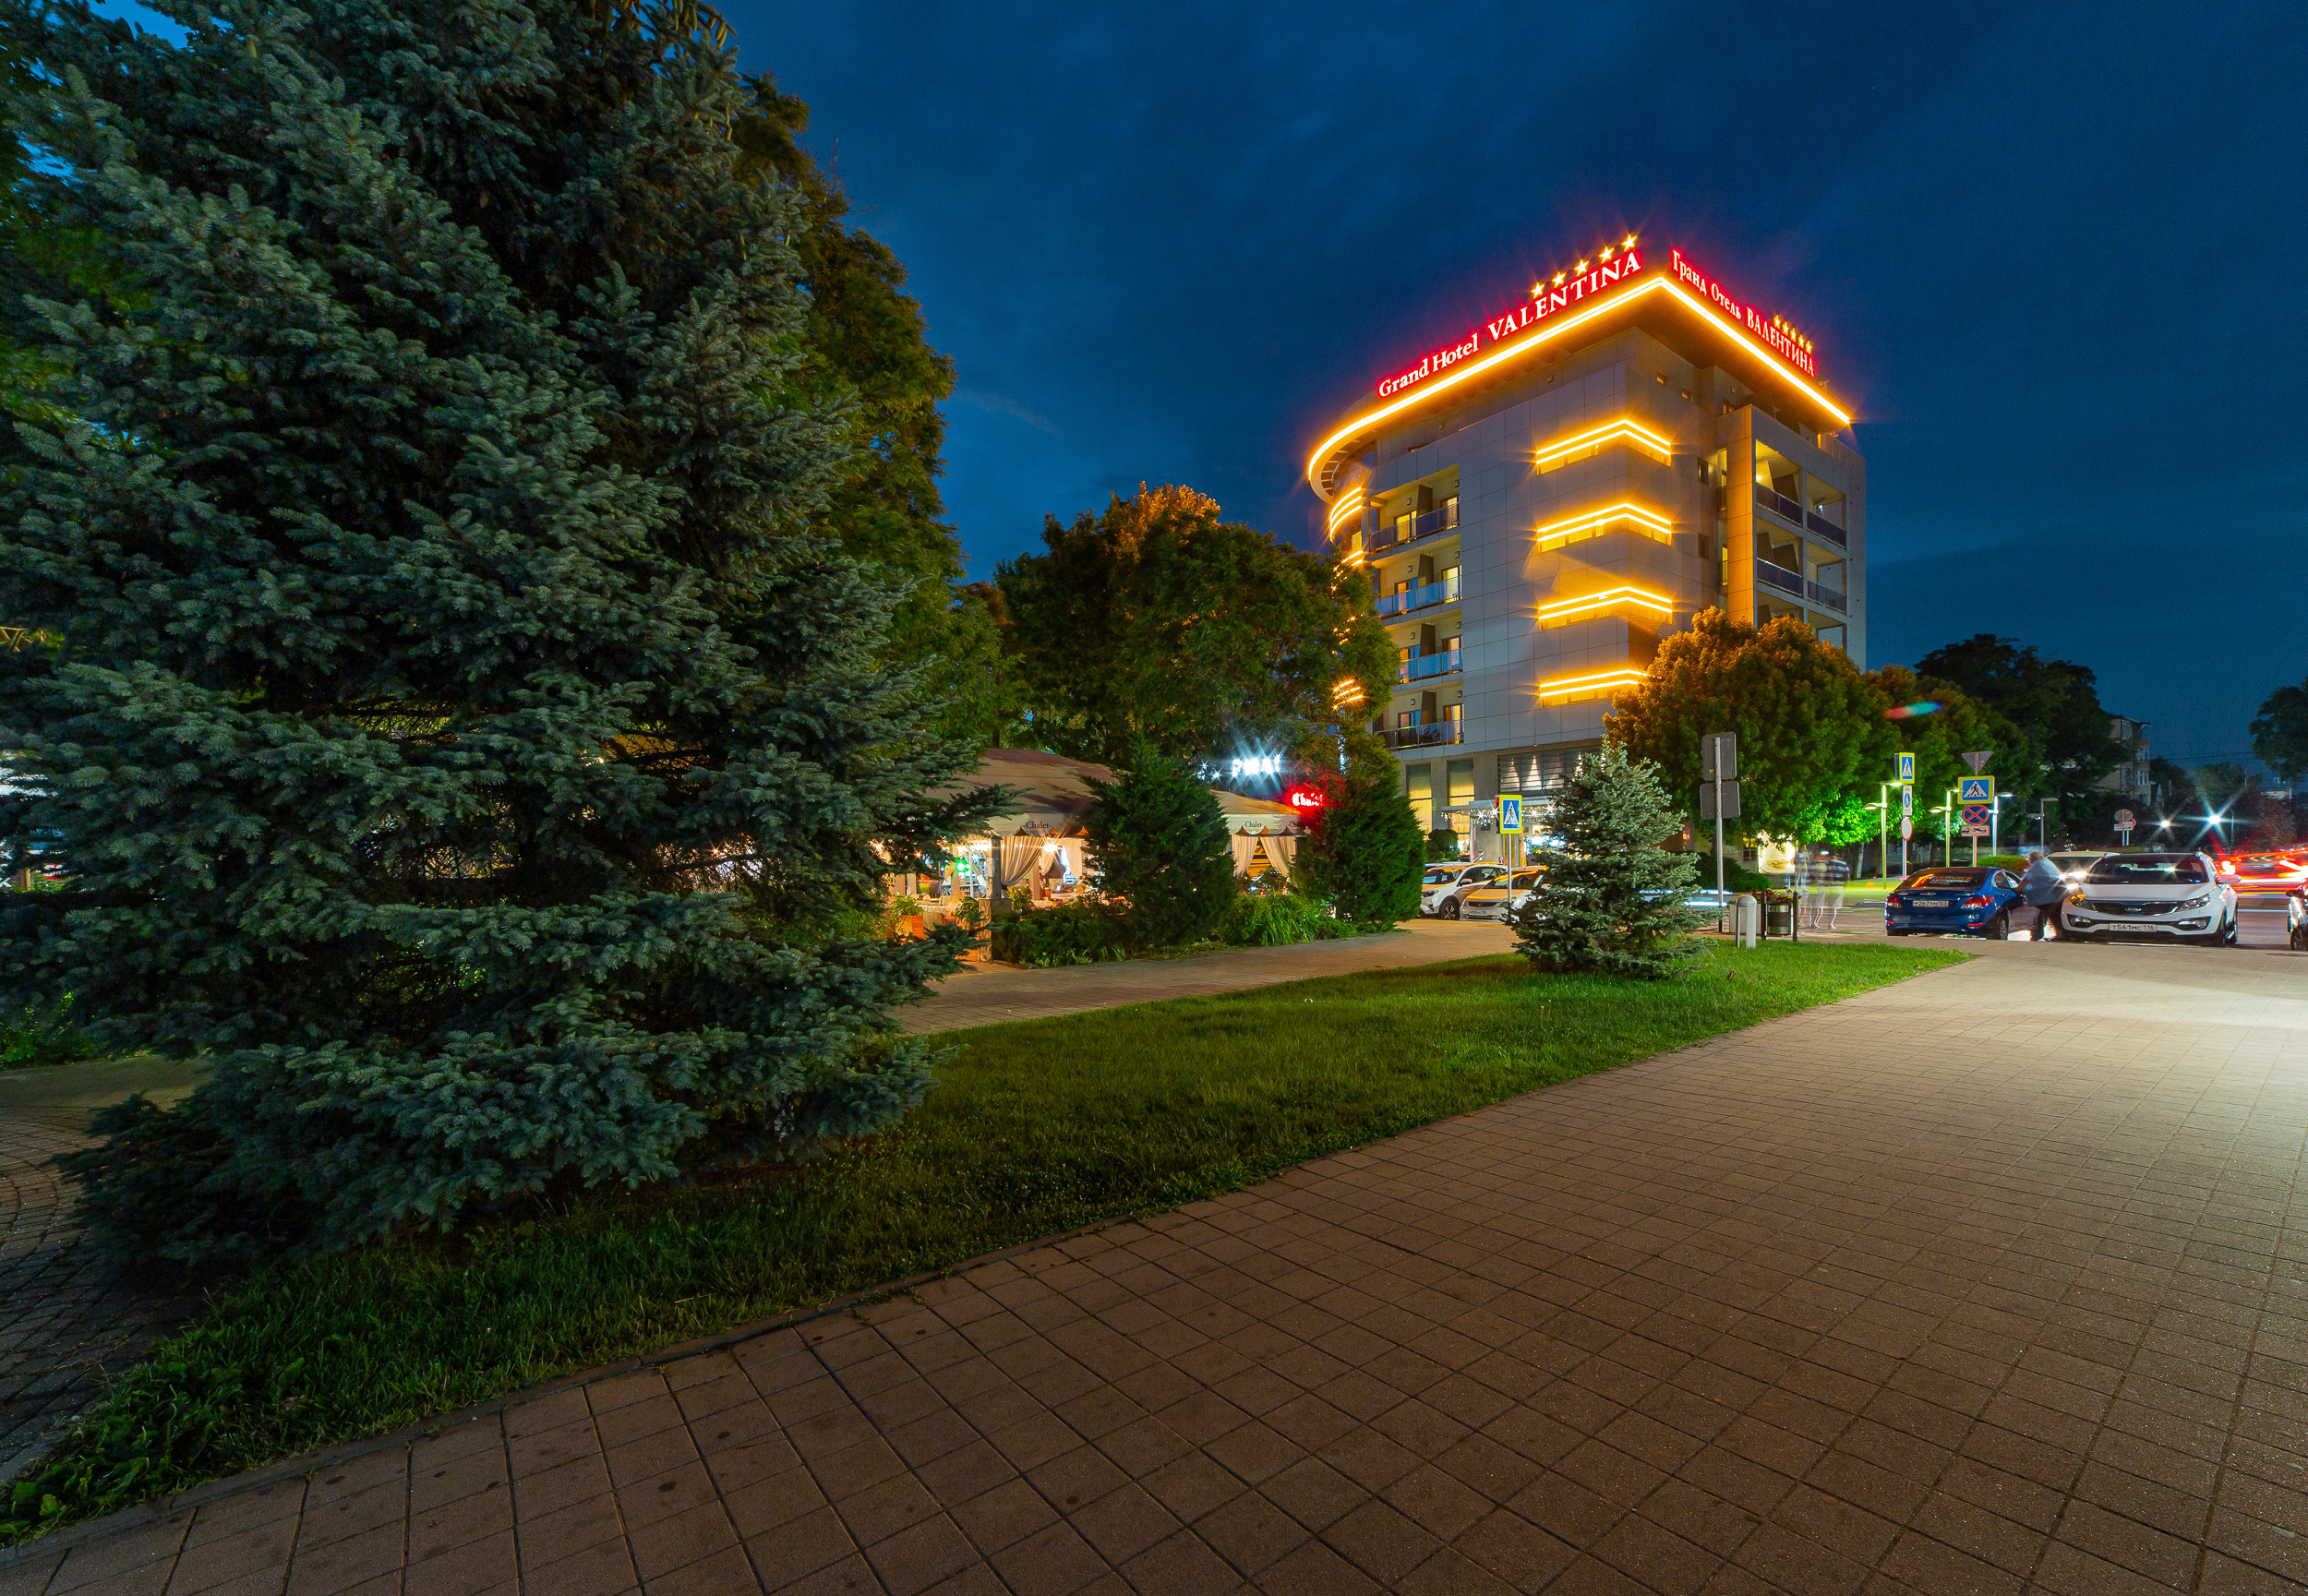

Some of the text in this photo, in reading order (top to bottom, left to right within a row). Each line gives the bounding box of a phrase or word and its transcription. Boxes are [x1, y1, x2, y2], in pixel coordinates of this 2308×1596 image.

[1378, 251, 1641, 397] Grand Hotel VALENTINA
[1673, 249, 1815, 378] Гранд Отель ВАЛЕНТИНА
